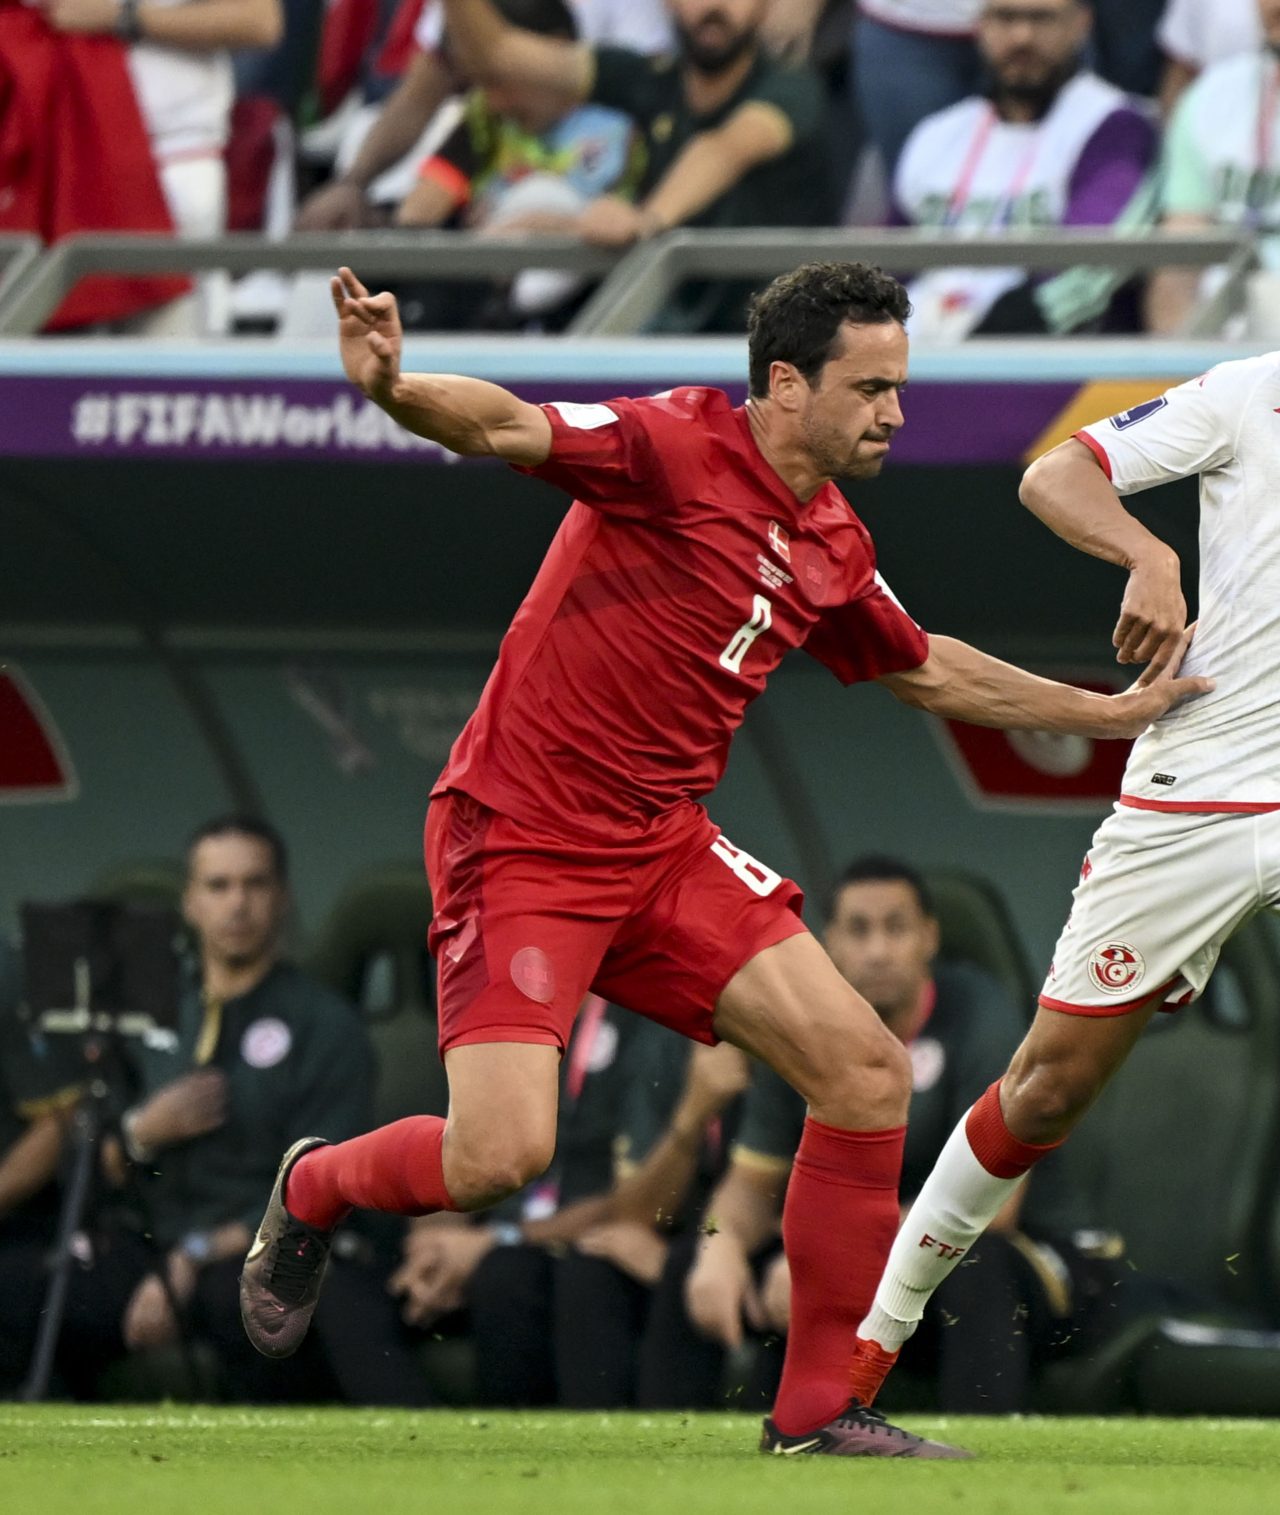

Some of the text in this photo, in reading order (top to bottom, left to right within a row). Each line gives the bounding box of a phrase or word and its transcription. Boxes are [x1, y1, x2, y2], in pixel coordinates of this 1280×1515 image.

[73, 393, 460, 464] #FIFAWorld
[719, 593, 772, 674] 8
[710, 834, 782, 897] 8
[919, 1233, 966, 1260] FTF
